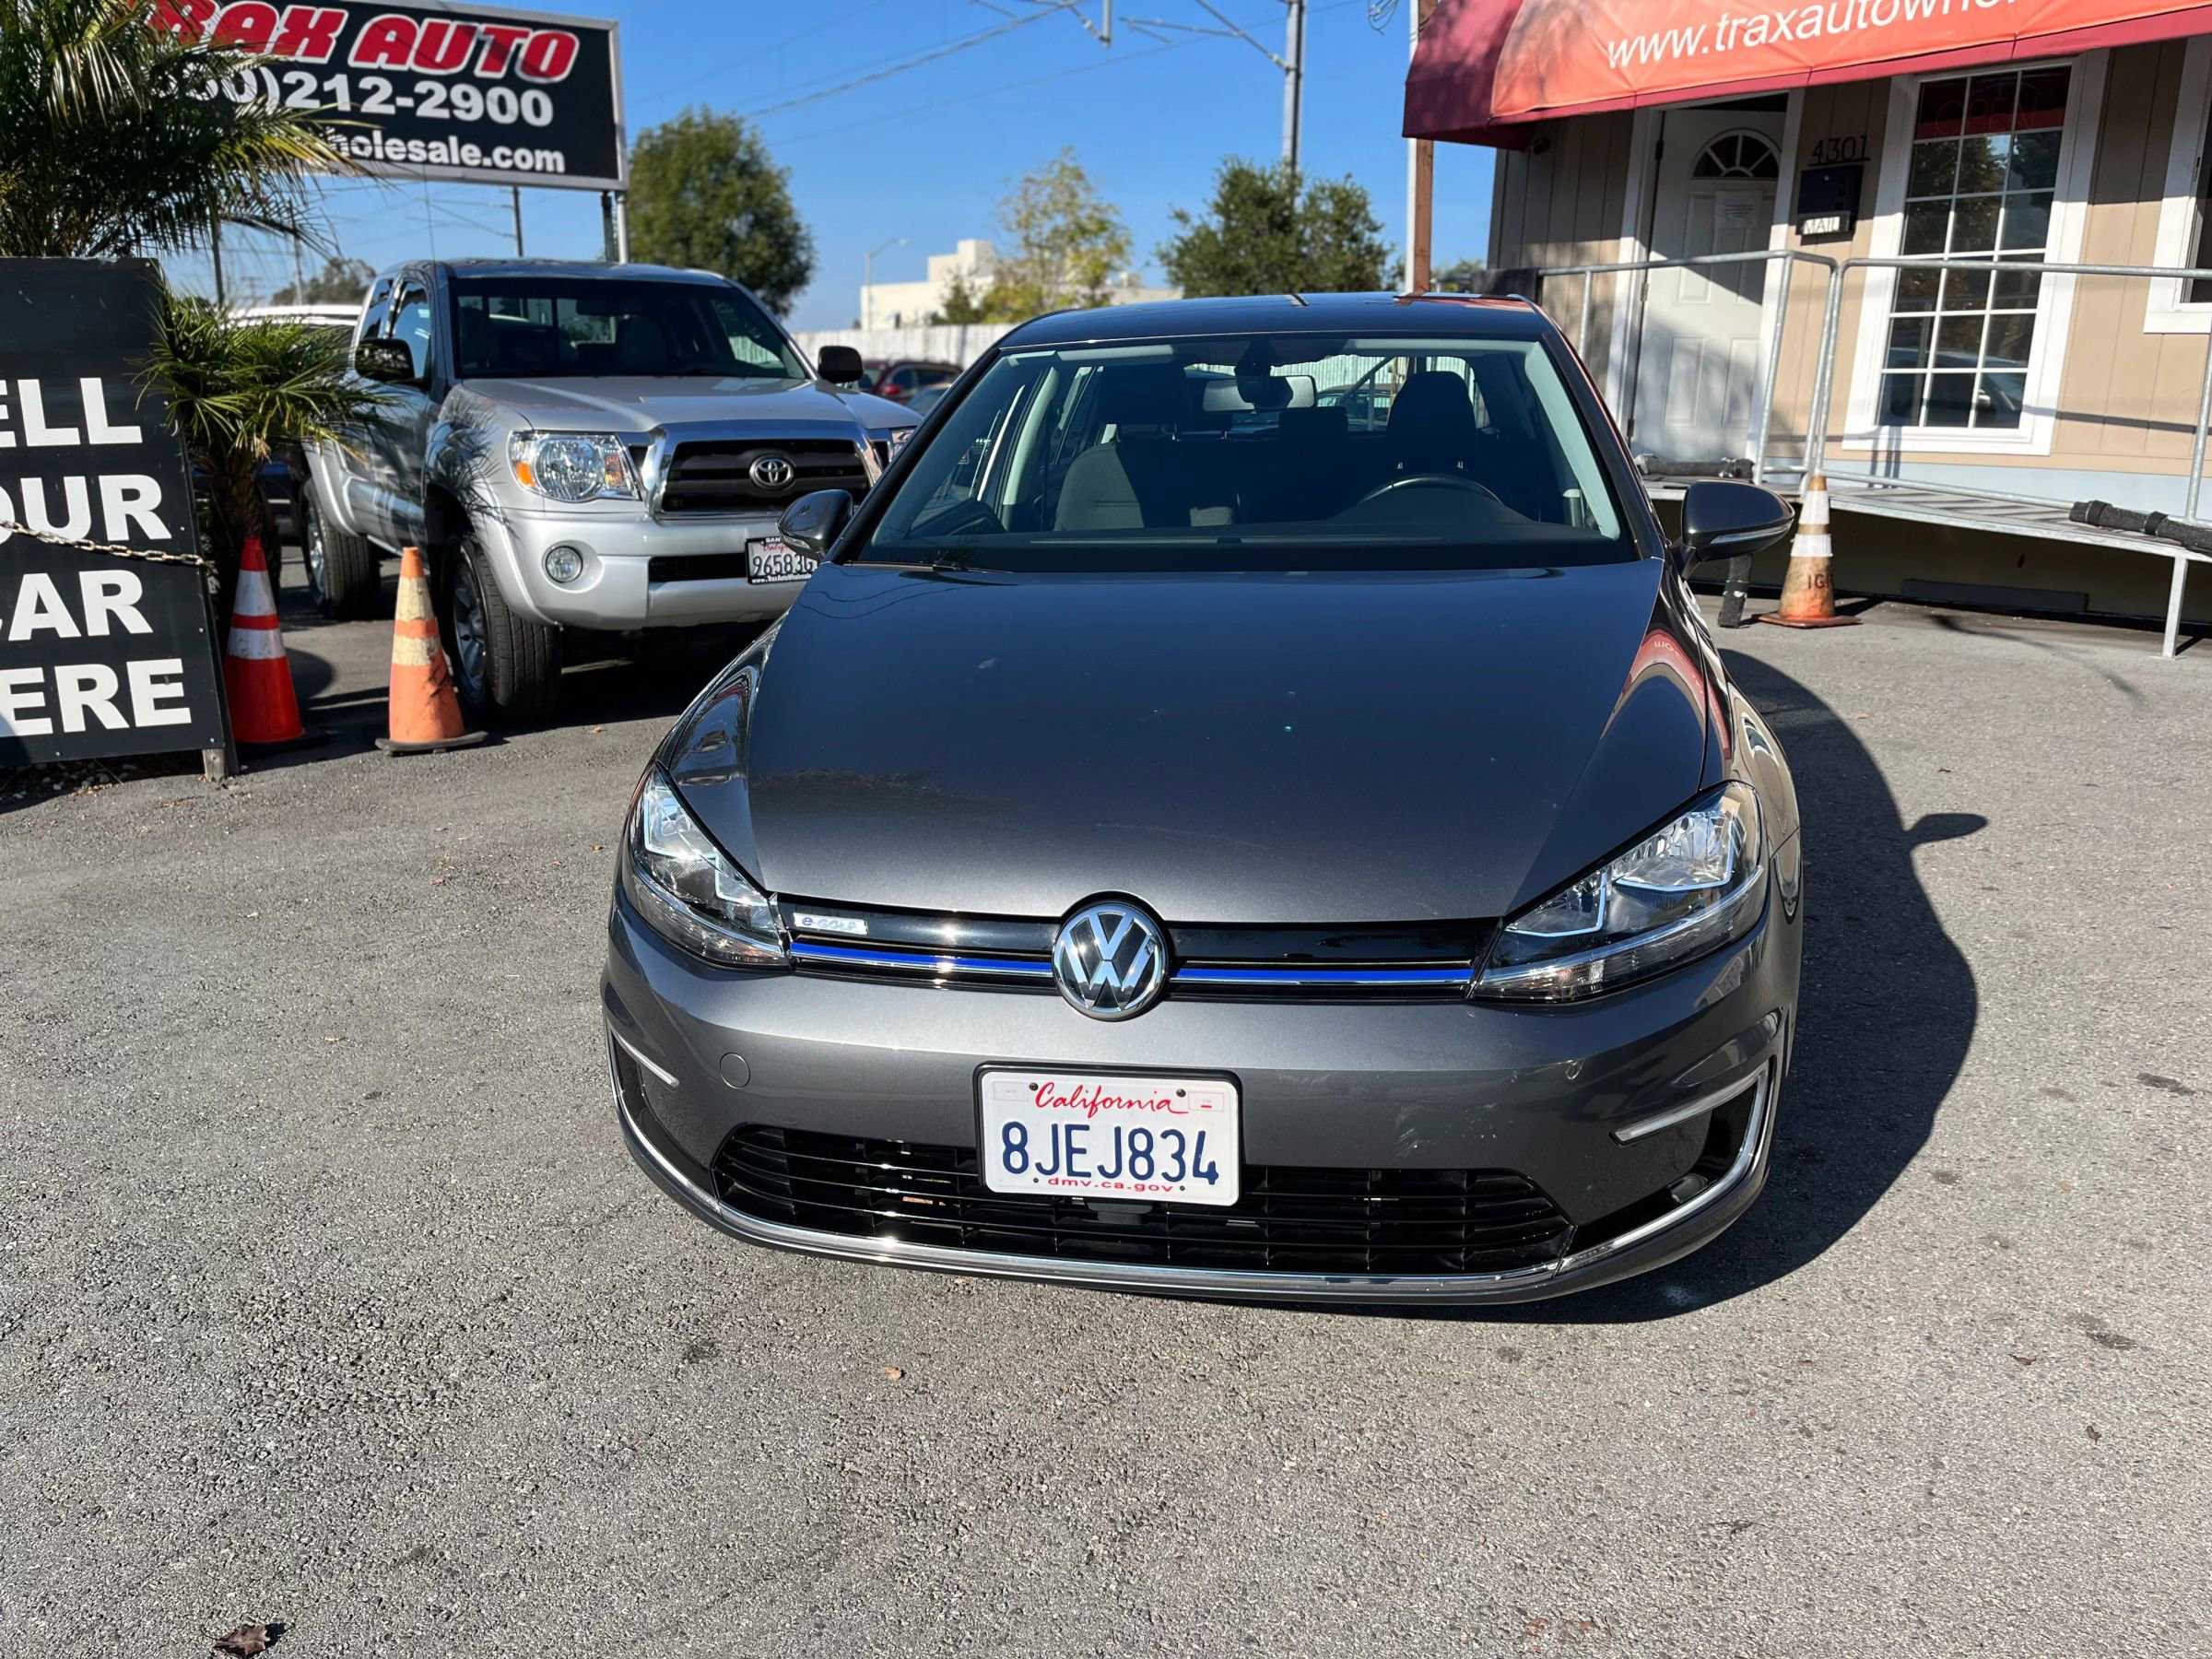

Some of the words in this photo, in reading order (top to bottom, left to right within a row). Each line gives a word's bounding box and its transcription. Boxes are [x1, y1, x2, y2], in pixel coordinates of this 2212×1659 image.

[126, 0, 348, 64] RAX
[348, 14, 580, 83] AUTO
[1810, 134, 1871, 164] 4301
[0, 570, 153, 641] AR
[1035, 1082, 1189, 1118] California
[1002, 1121, 1219, 1186] 8JEJ834
[1048, 1176, 1173, 1193] dmv.ca.gov
